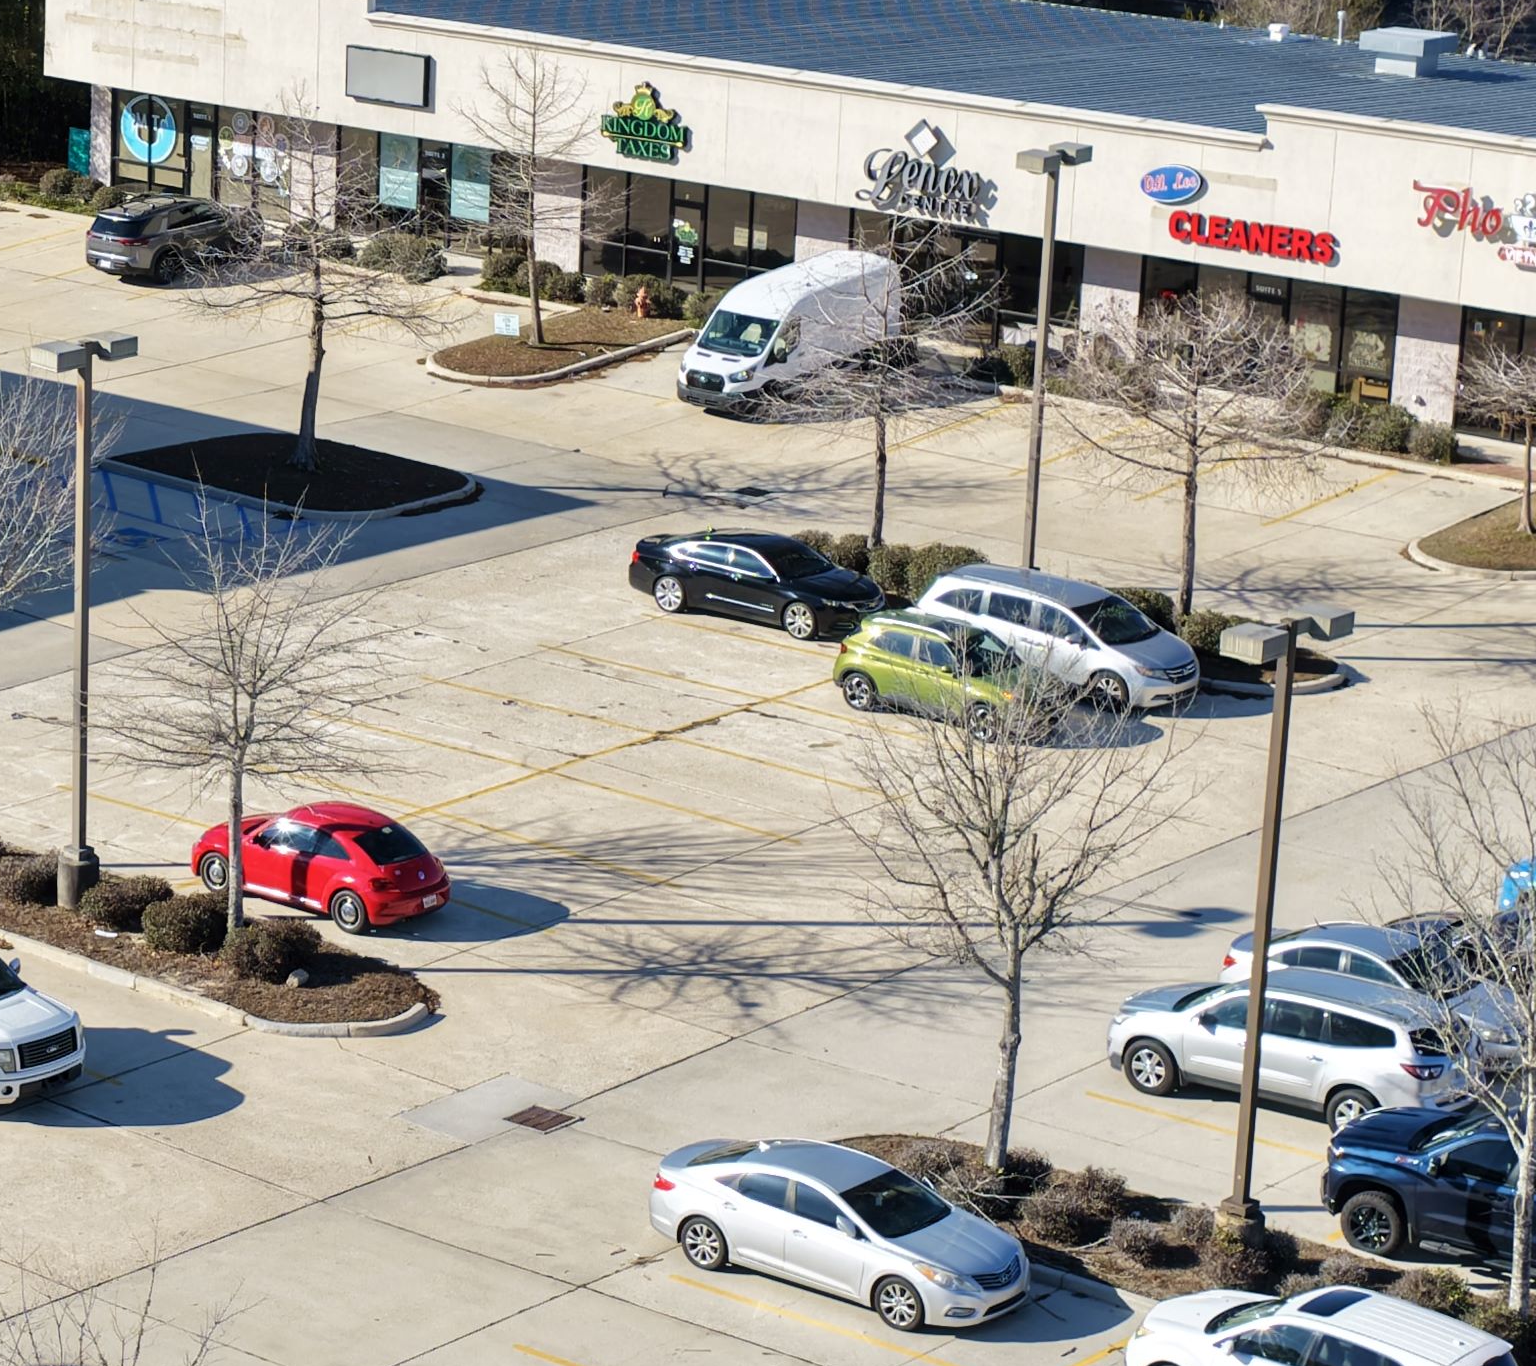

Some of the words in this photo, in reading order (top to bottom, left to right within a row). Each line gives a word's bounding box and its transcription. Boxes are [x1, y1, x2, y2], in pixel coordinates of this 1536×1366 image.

[601, 115, 685, 142] KINGDOM
[615, 136, 671, 160] TAXES
[855, 148, 980, 205] Lenox
[900, 194, 970, 218] CENTRE
[1412, 178, 1504, 236] Pho
[1168, 209, 1335, 263] CLEANERS
